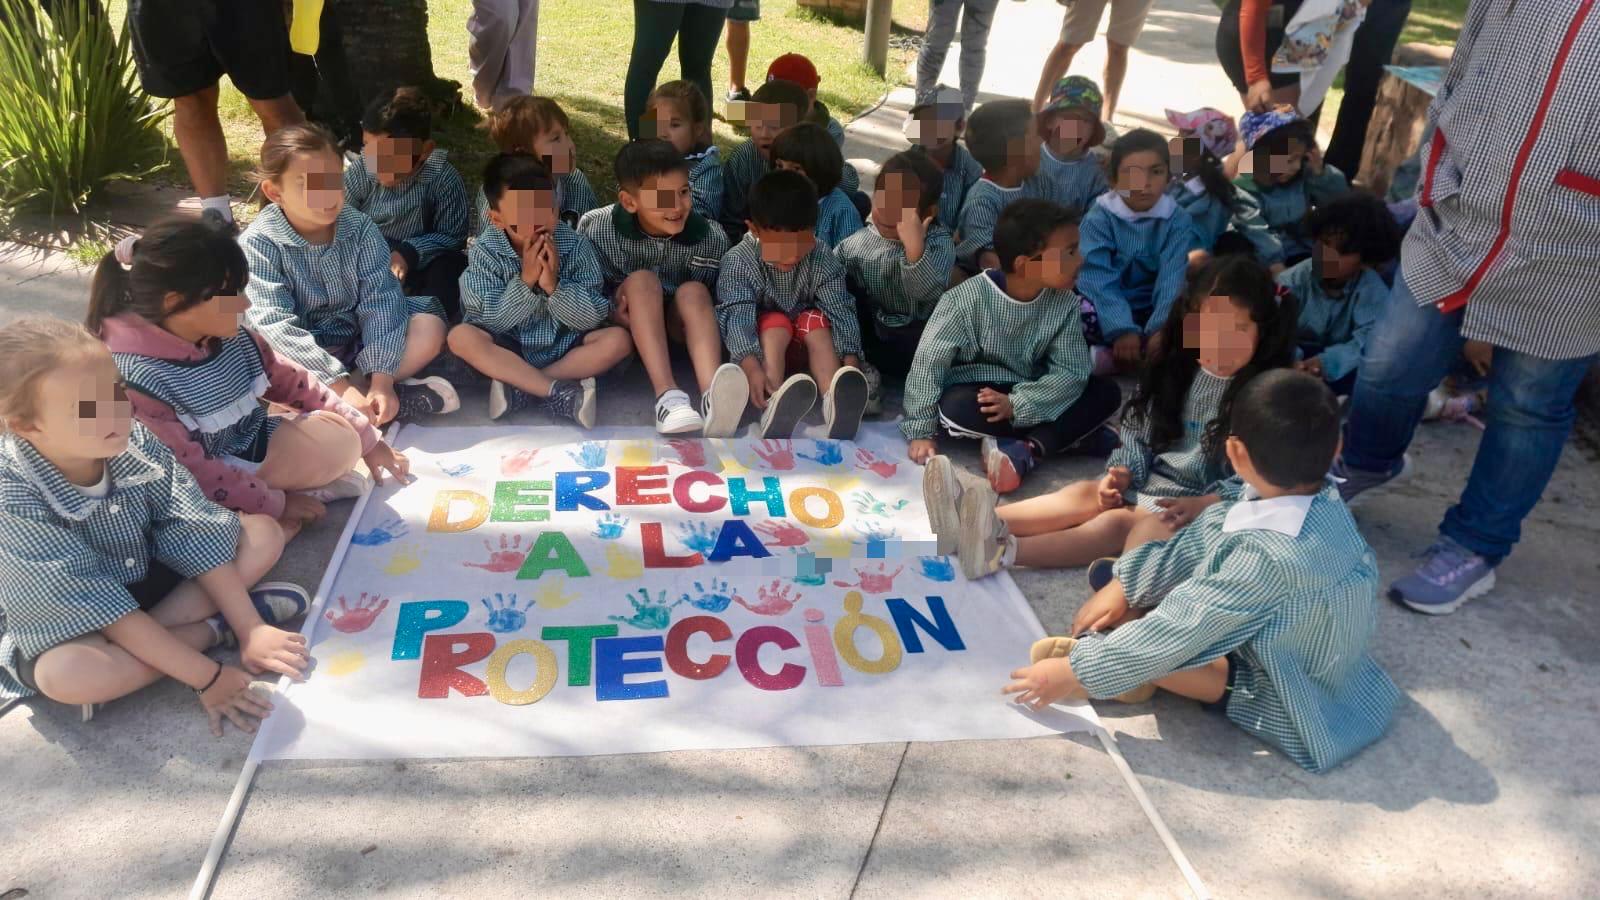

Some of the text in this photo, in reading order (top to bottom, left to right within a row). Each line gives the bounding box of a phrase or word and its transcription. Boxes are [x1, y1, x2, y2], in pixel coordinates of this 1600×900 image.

[426, 465, 845, 533] DERECHO
[515, 519, 771, 580] A LA
